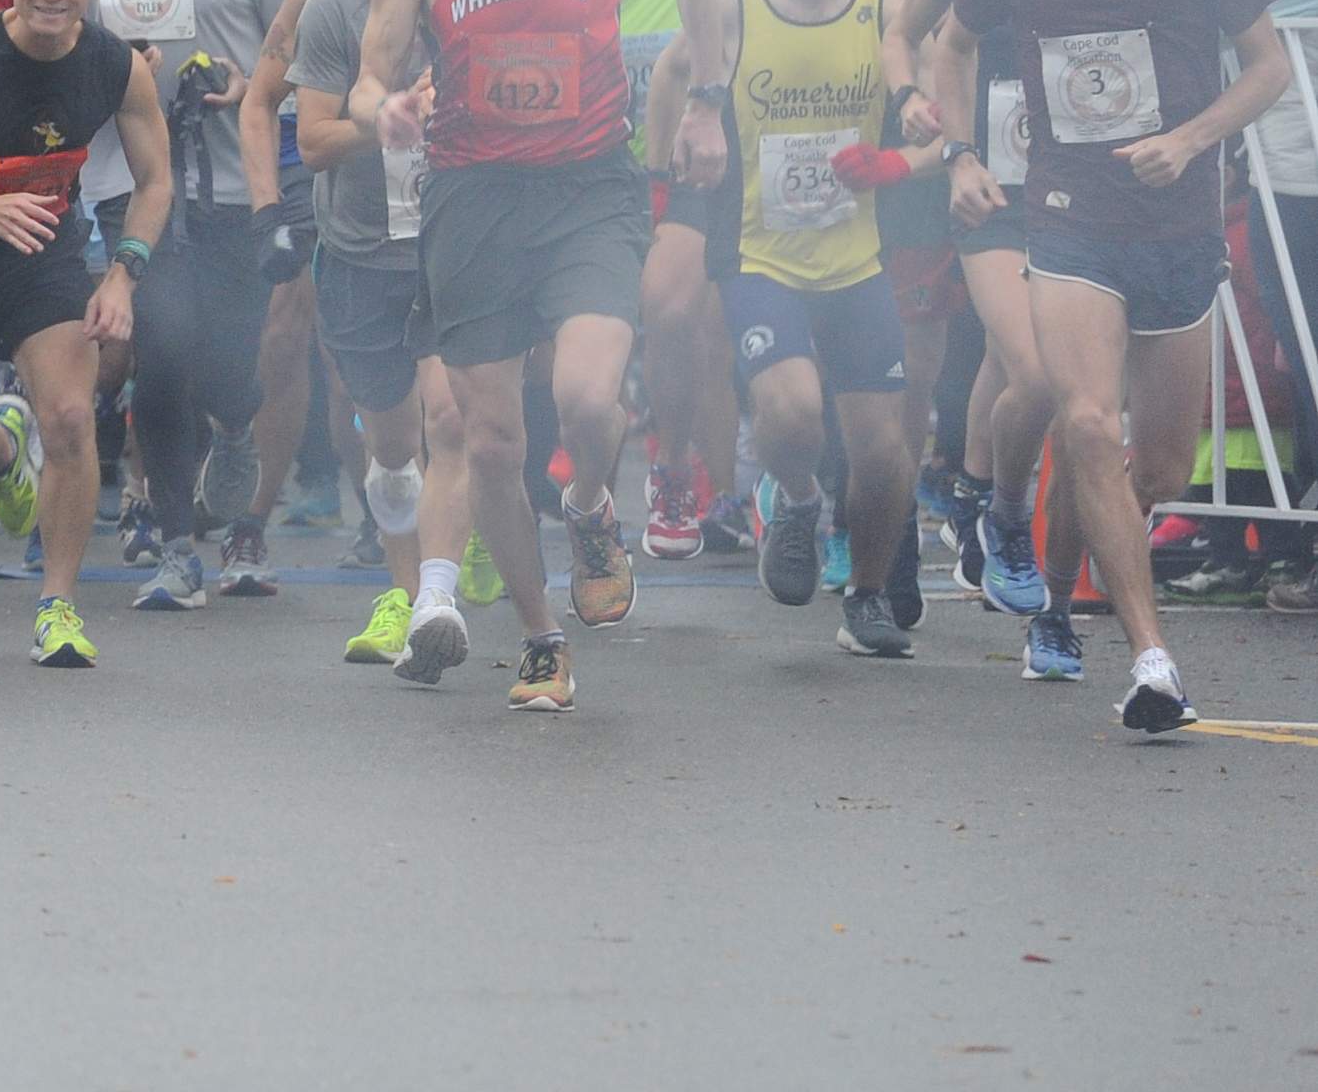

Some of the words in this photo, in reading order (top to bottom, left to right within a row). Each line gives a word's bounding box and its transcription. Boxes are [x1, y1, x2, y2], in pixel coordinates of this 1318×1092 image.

[1063, 39, 1093, 52] Cape
[1096, 35, 1120, 47] Cod
[1087, 69, 1105, 95] 3
[487, 82, 560, 110] 4122
[770, 105, 808, 121] ROAD
[784, 137, 812, 148] Cape
[786, 166, 836, 191] 534
